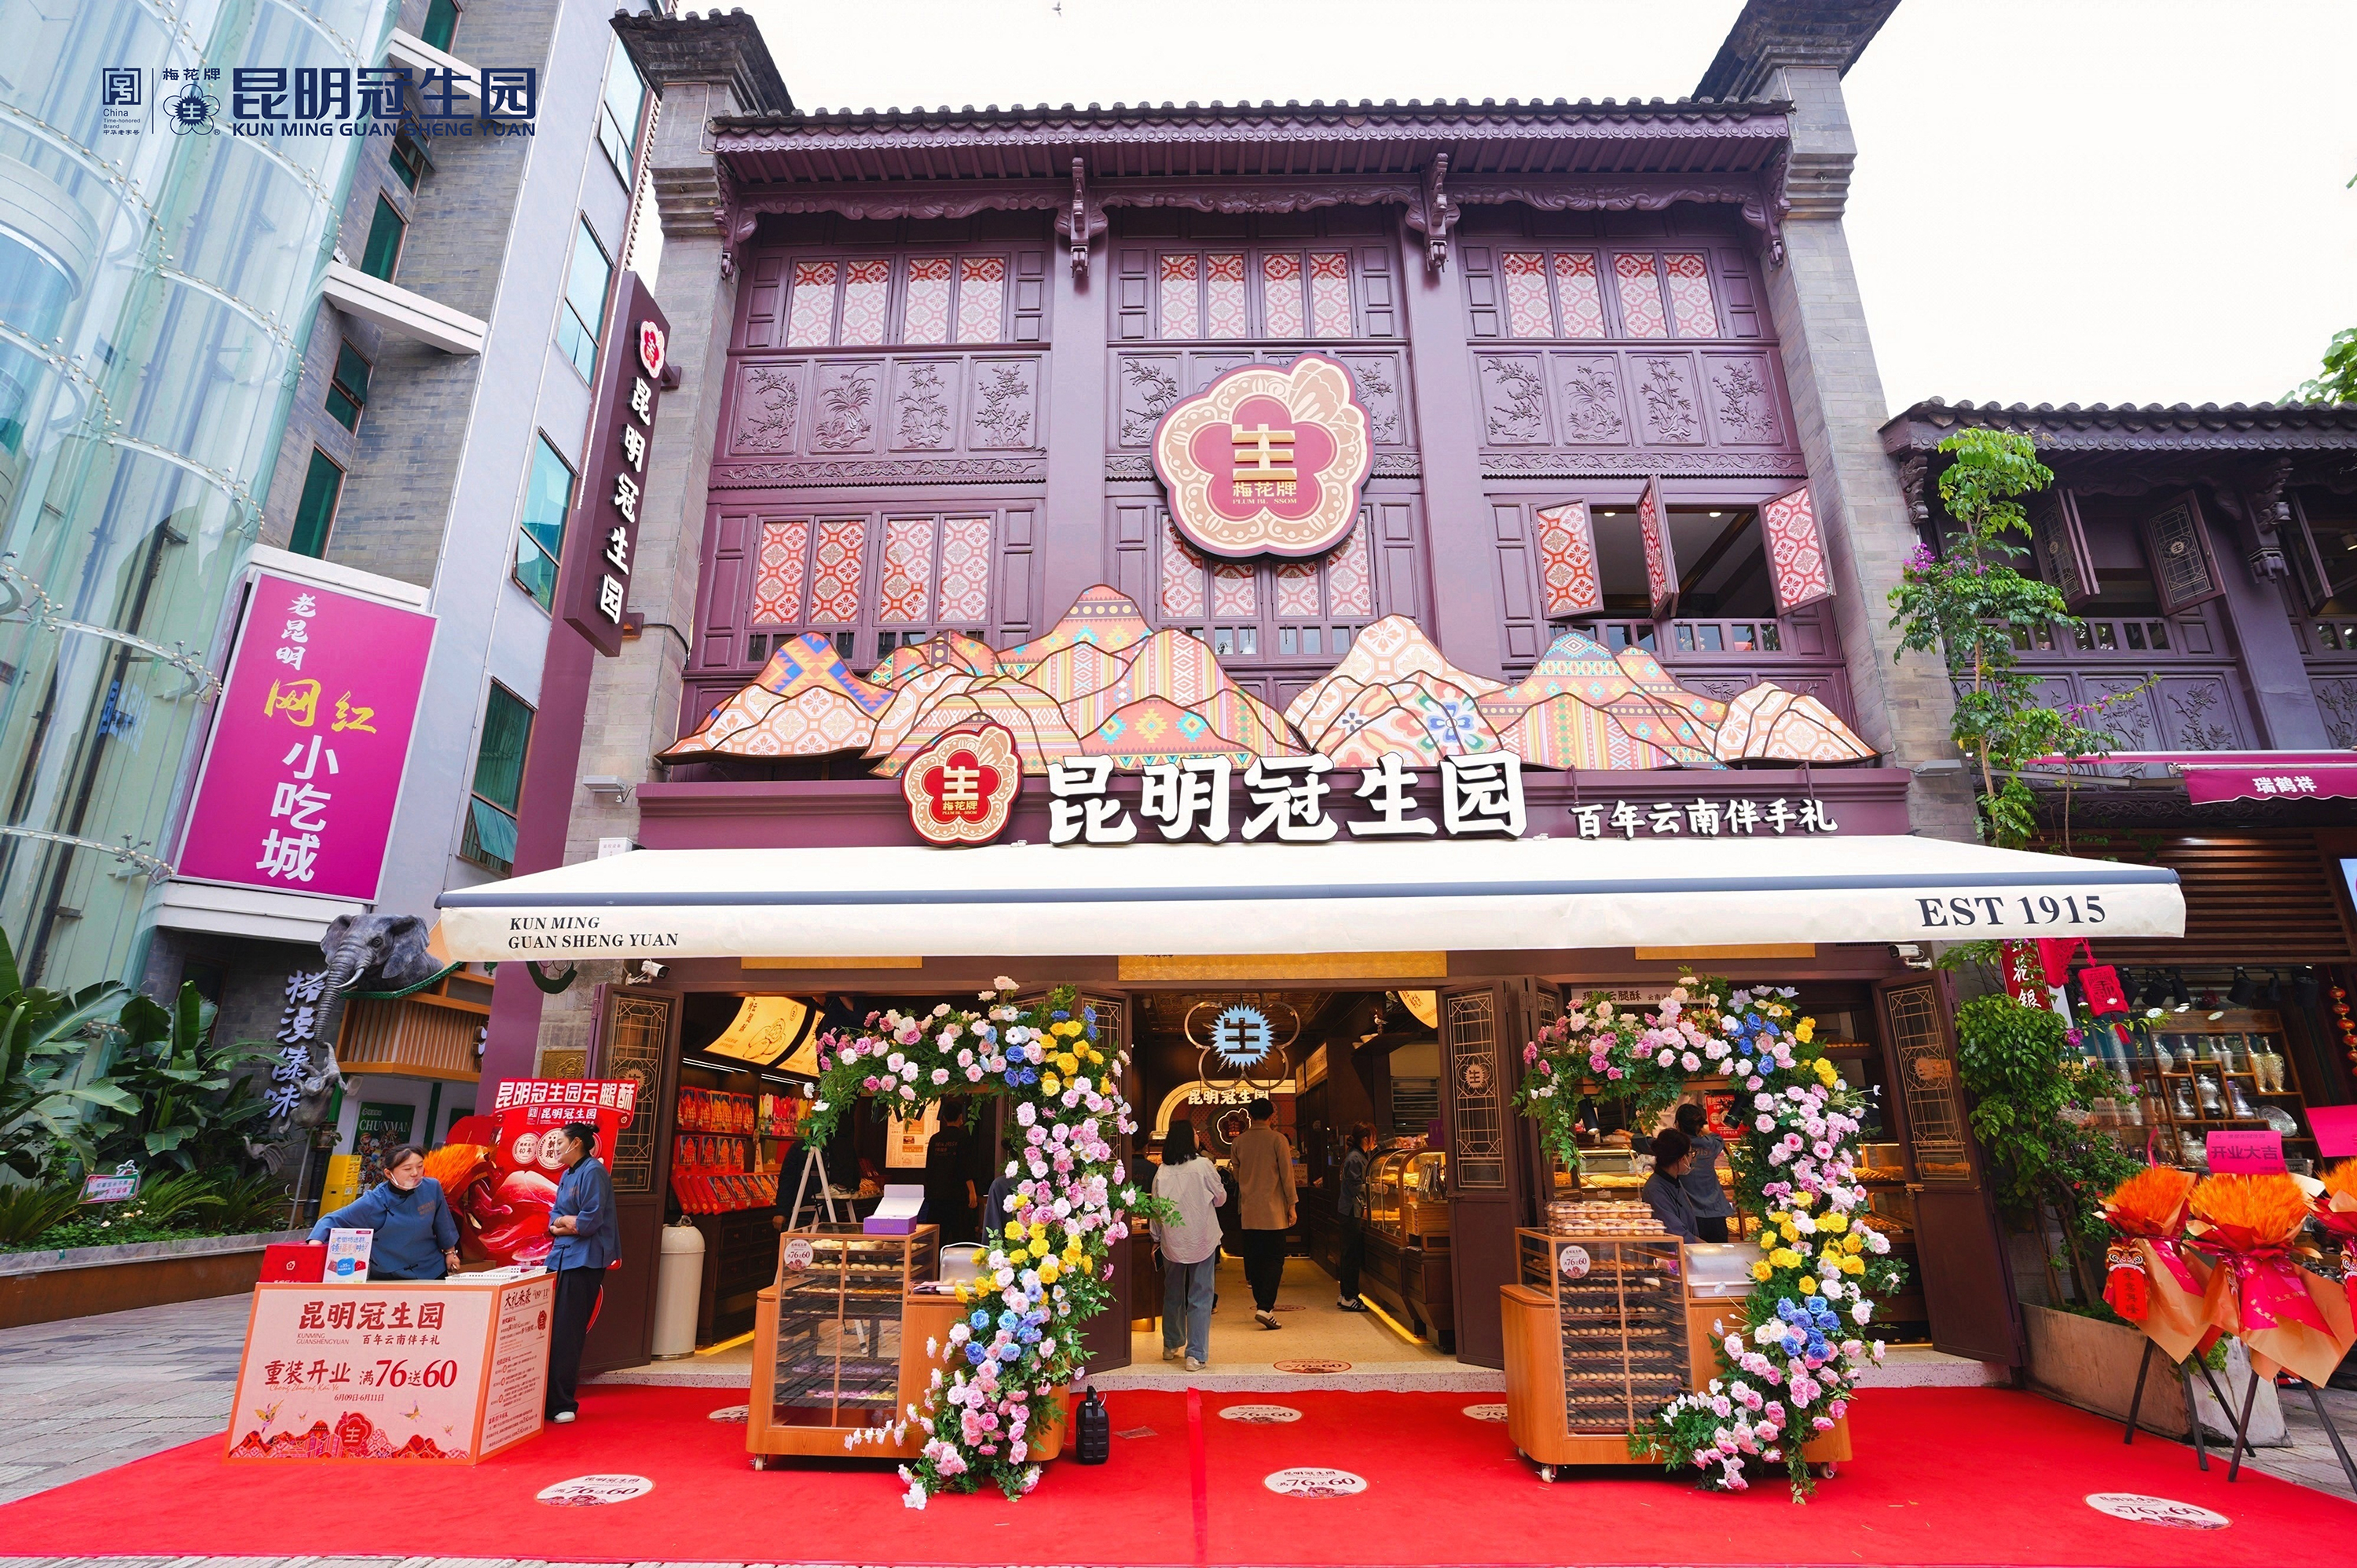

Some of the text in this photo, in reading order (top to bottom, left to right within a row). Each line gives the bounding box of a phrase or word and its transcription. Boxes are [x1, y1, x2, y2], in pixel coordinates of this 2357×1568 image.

[599, 376, 653, 625] 昆明冠生园
[1232, 481, 1297, 497] 梅花牌
[276, 592, 317, 671] 老昆明
[264, 678, 377, 734] 网红
[2252, 775, 2318, 794] 瑞鹤祥
[256, 734, 339, 883] 小吃城
[942, 801, 978, 811] 梅花牌
[1046, 750, 1528, 845] 昆明冠生园
[1569, 797, 1839, 841] 百年云南伴手礼
[1915, 895, 2106, 927] EST 1915
[510, 917, 599, 930] KUN MING
[508, 932, 679, 949] GUAN SHENG YUAN
[1582, 991, 1642, 1002] 现云腿酥
[495, 1082, 636, 1111] 昆明冠生园云腿酥
[541, 1108, 597, 1120] 昆明冠生园
[2211, 1145, 2278, 1160] 开业大吉
[299, 1301, 445, 1330] 昆明冠生园
[362, 1335, 441, 1346] 百年云南伴手礼
[265, 1359, 457, 1388] 重装开业 满76送60
[269, 1383, 290, 1393] Chong
[291, 1383, 316, 1393] Zhuang
